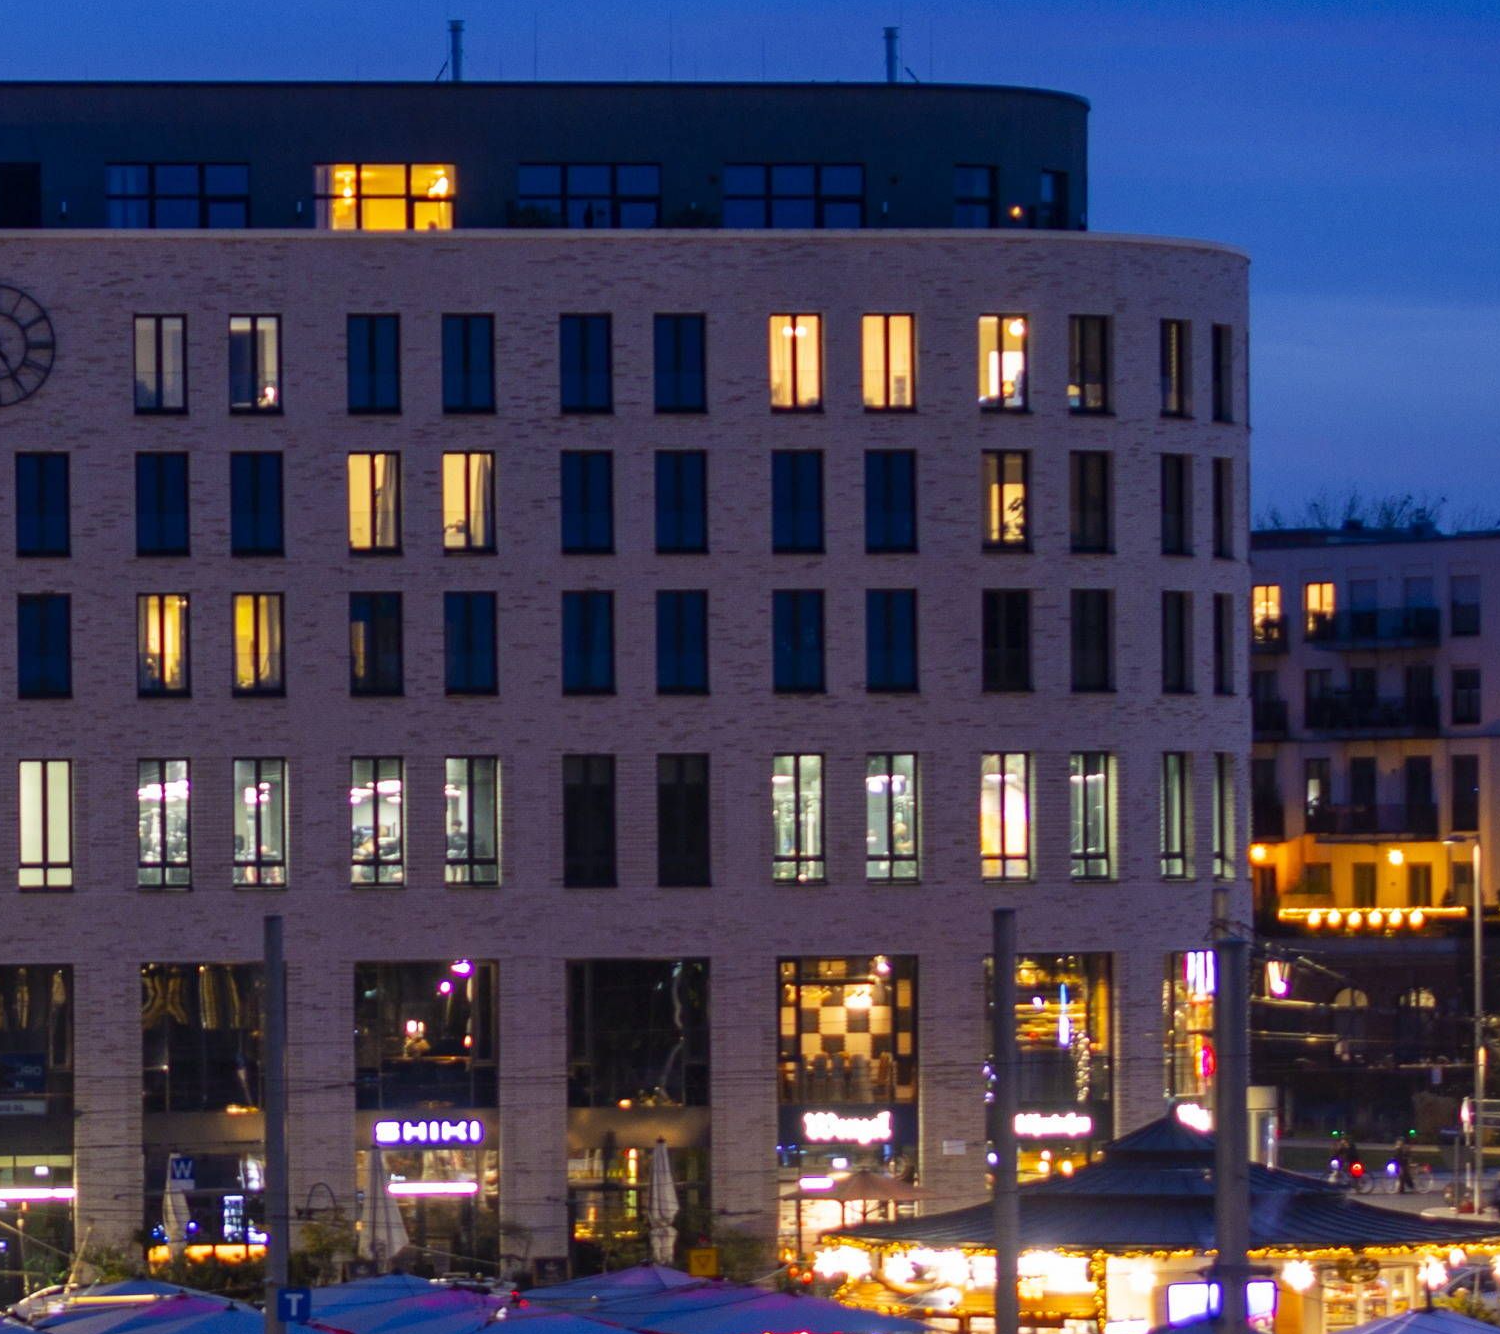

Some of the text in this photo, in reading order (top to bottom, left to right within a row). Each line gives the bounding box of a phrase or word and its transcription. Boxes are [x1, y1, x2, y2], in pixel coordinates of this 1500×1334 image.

[376, 1120, 480, 1142] SHIKI
[173, 1160, 192, 1179] W
[284, 1293, 304, 1317] T
